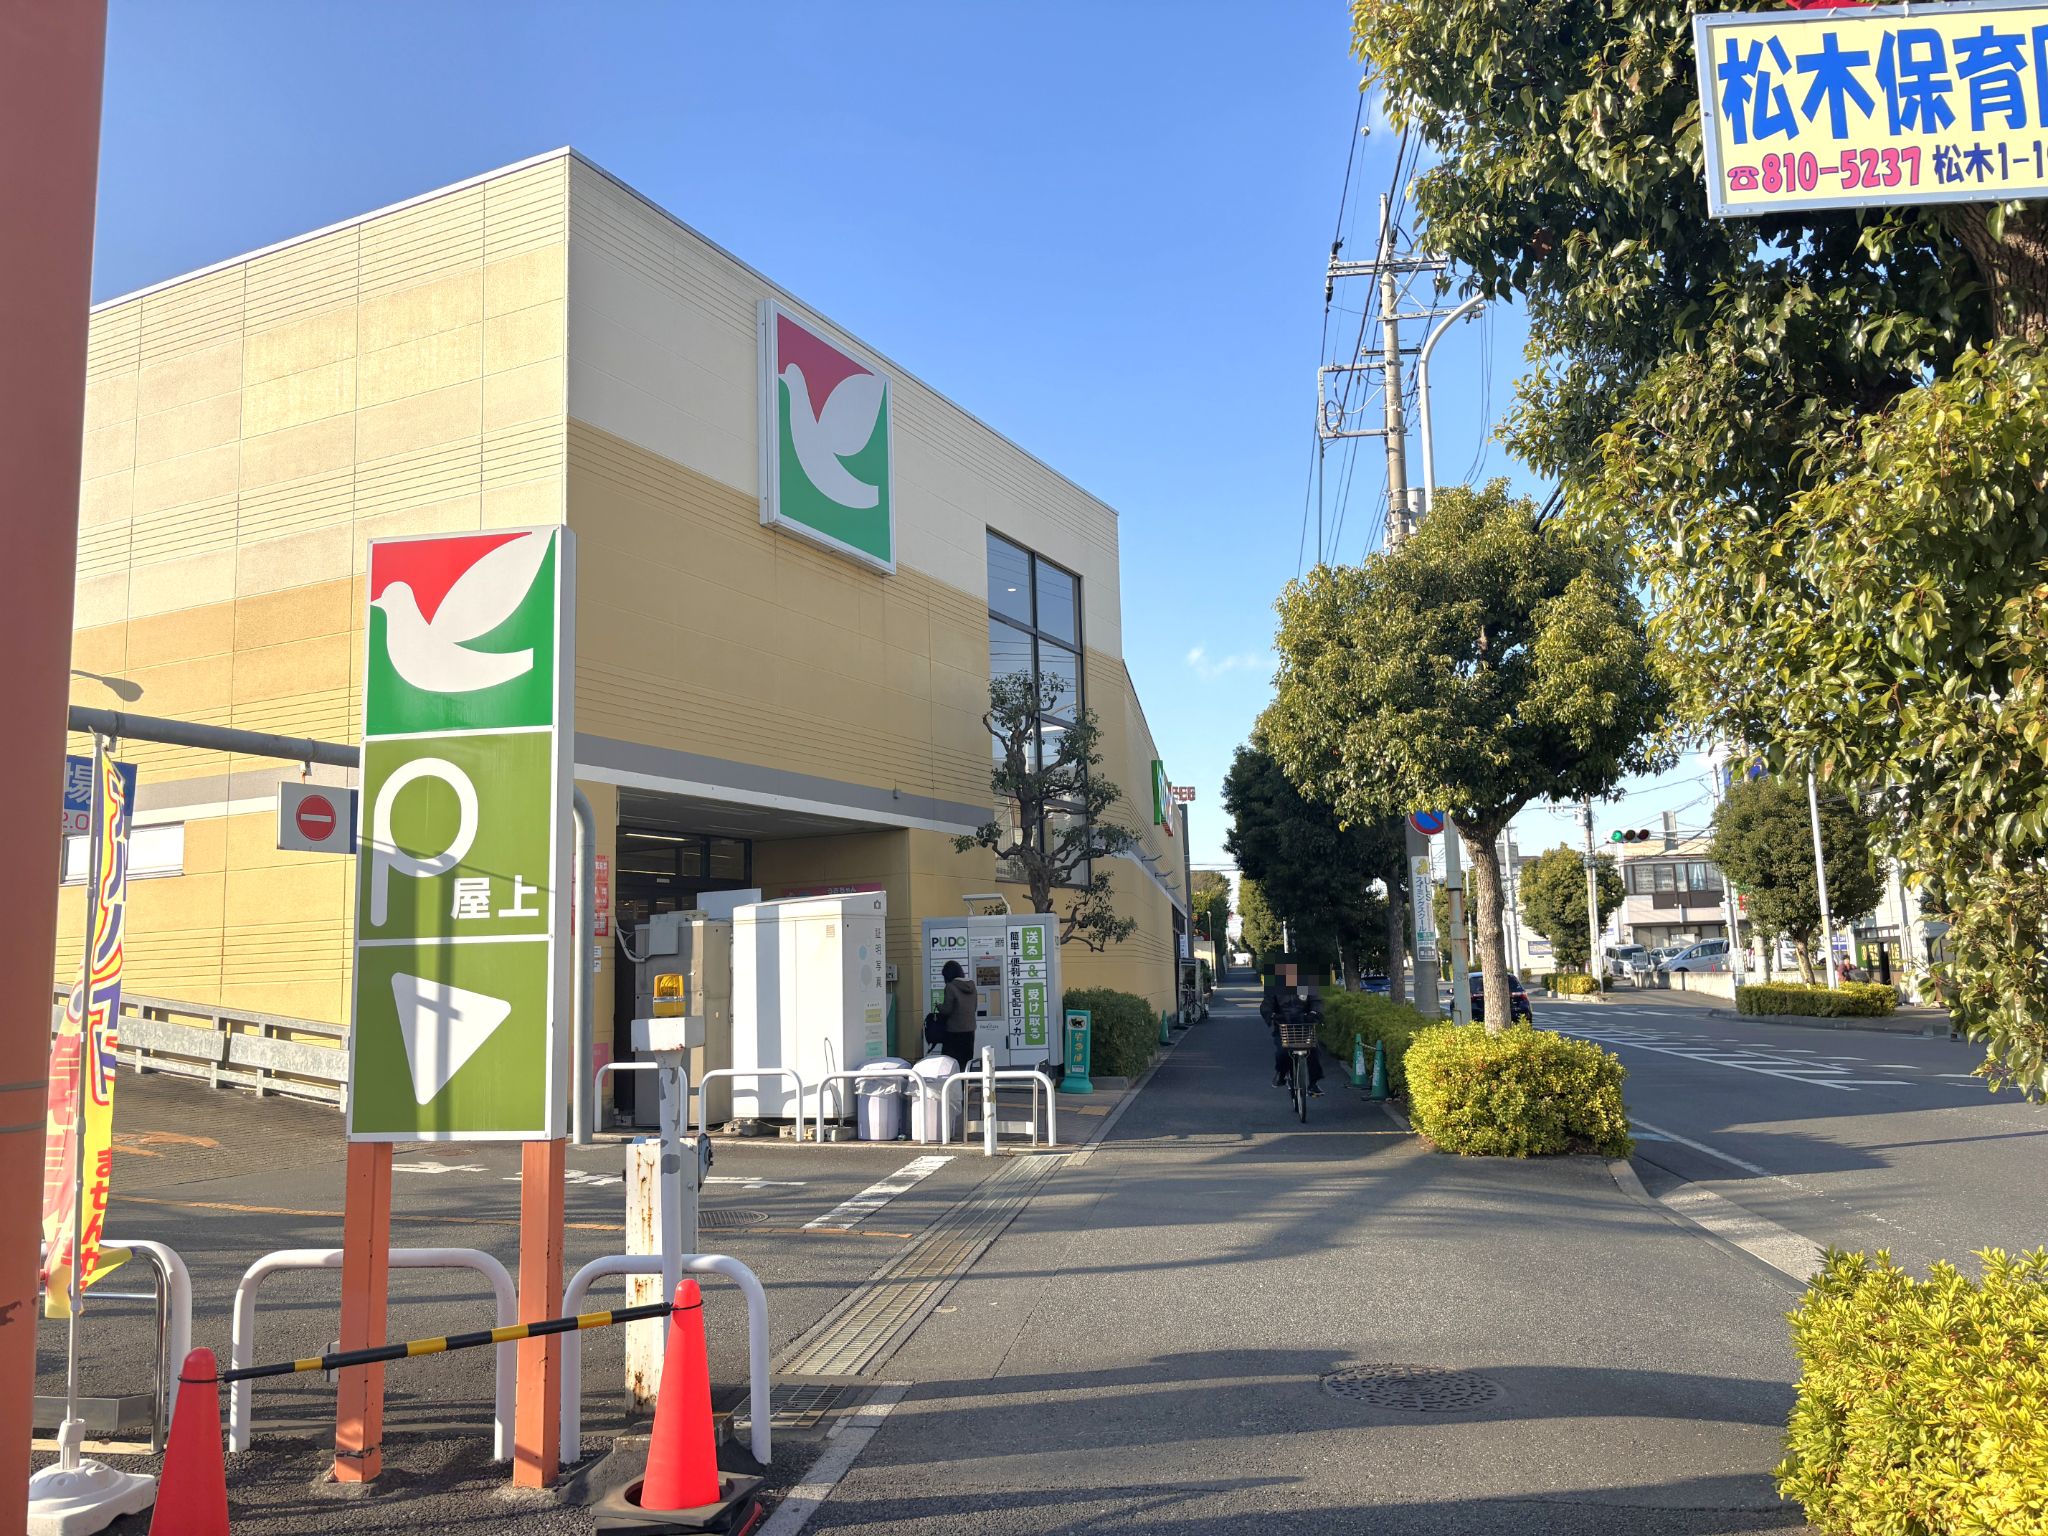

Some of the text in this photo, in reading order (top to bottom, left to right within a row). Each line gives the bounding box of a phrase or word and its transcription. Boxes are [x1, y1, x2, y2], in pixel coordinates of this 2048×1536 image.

[1762, 140, 2048, 193] 810-5237 松木1-1
[451, 874, 539, 920] 屋上
[931, 936, 967, 948] PUDO
[1025, 930, 1038, 956] 送る
[1027, 988, 1041, 1040] 受け取る
